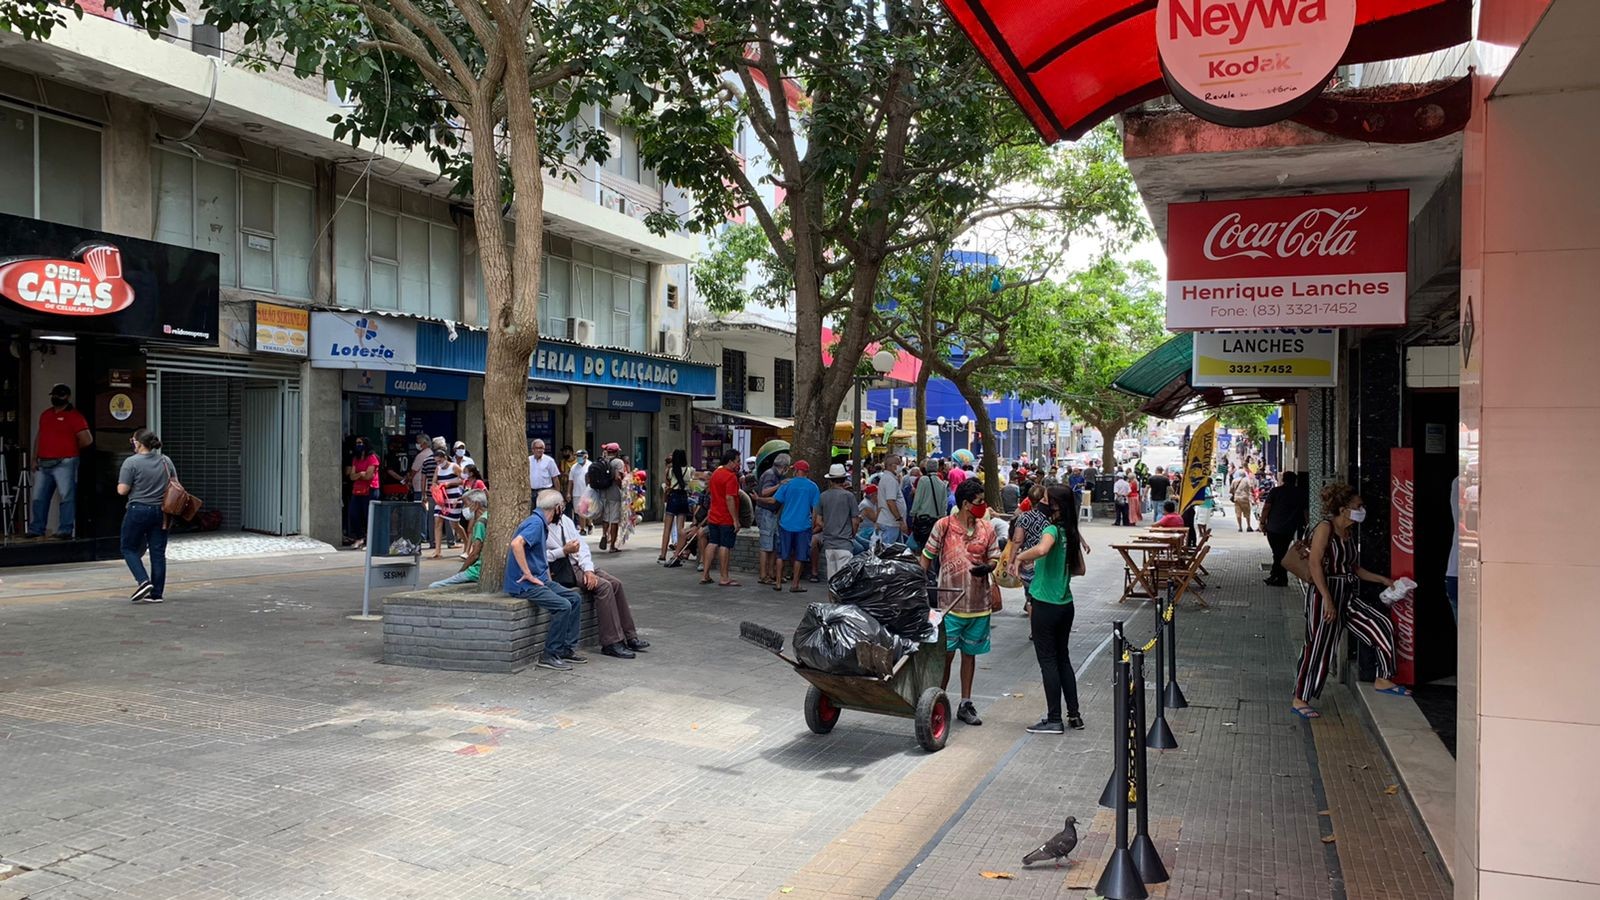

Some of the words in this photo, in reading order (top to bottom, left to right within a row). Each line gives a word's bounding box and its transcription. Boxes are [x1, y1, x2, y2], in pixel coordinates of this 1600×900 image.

[1168, 0, 1327, 45] Neywa
[1208, 53, 1292, 79] Kodak
[1204, 90, 1235, 101] Revele
[1203, 205, 1368, 261] Coca-Cola
[17, 272, 113, 309] CAPAS
[1182, 281, 1284, 302] Henrique
[1291, 279, 1390, 297] Lanches
[56, 304, 95, 313] CELULARES
[1210, 305, 1248, 318] Fone:
[1252, 303, 1281, 318] (83)
[1285, 302, 1358, 316] 3321-7452
[331, 343, 395, 359] Loteria
[1222, 339, 1305, 353] LANCHES
[583, 356, 606, 376] DO
[611, 359, 679, 385] CALÇADÃO
[1229, 364, 1294, 374] 3321-7452
[394, 379, 427, 393] CALÇADÃO
[1391, 474, 1414, 554] Coca-Cola
